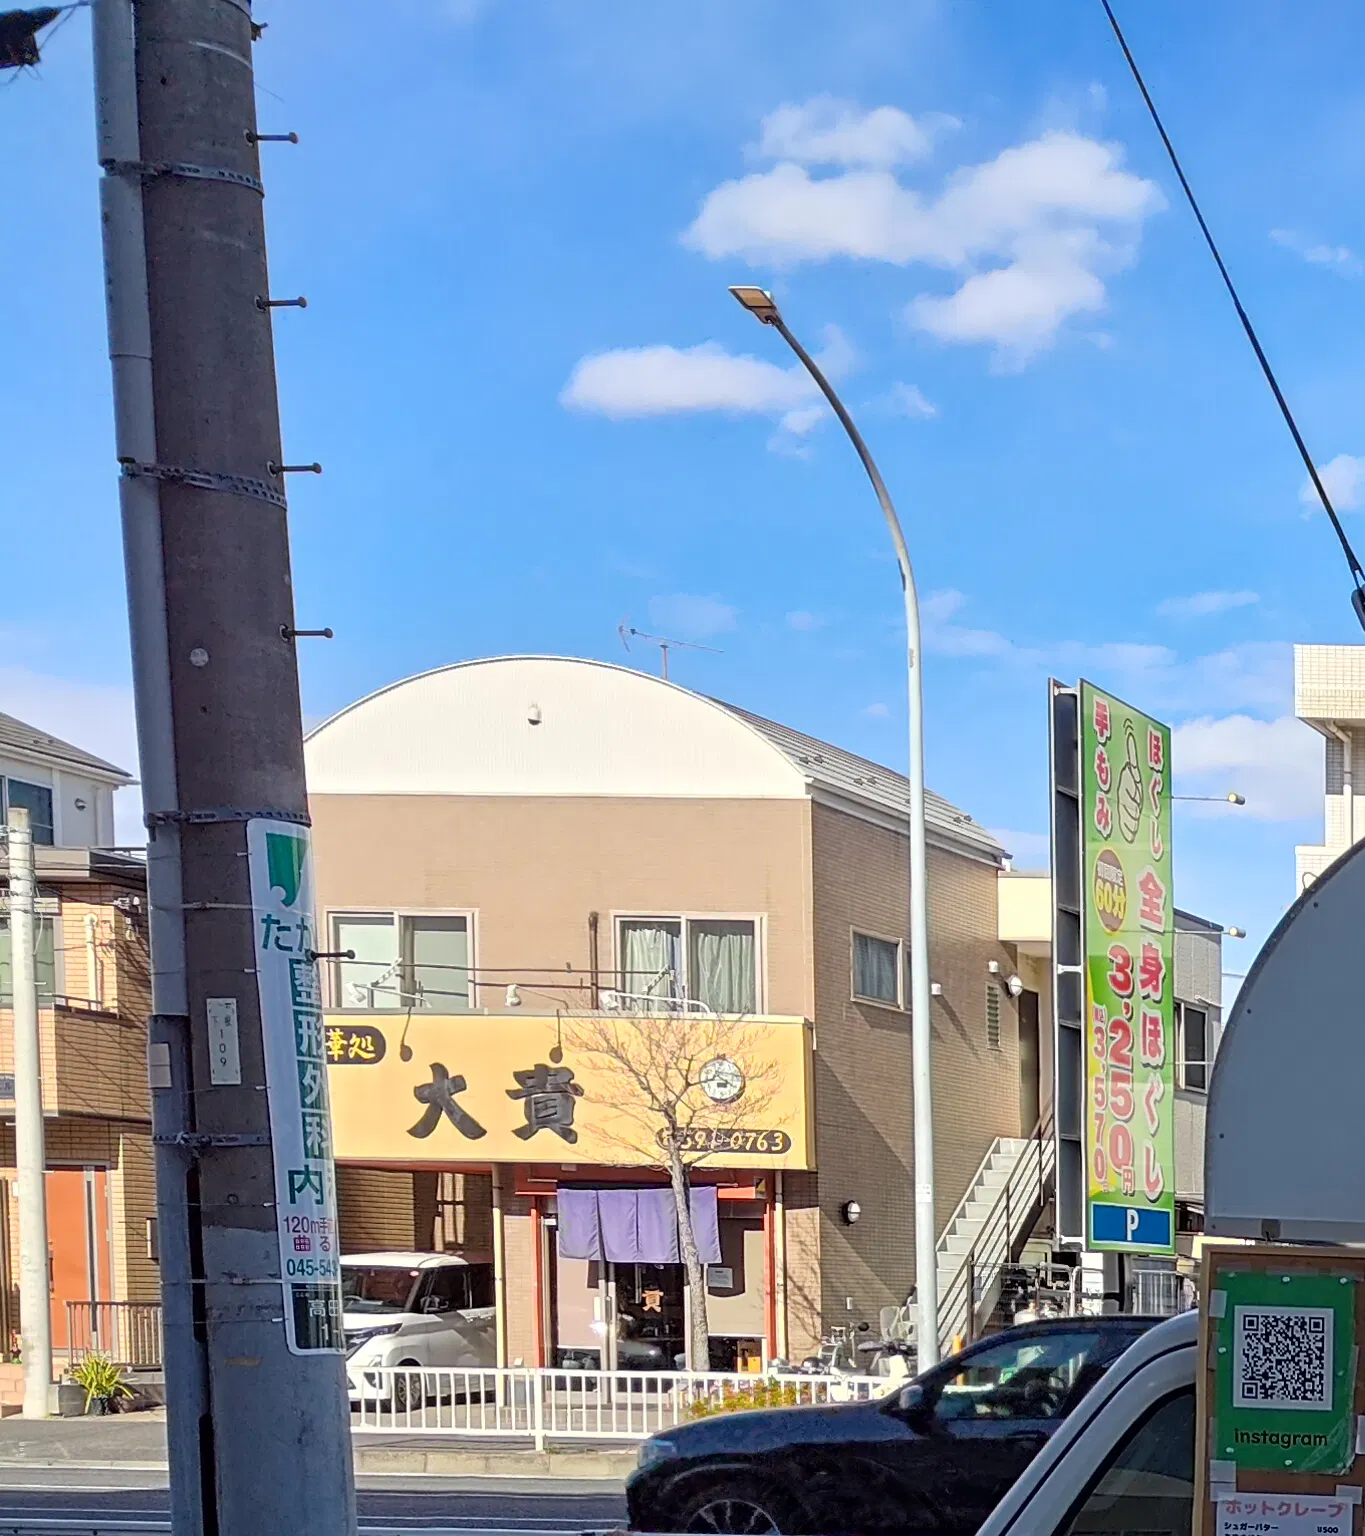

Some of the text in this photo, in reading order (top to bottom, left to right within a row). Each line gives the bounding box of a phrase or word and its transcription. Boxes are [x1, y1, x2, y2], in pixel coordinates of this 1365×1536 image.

[1094, 695, 1112, 840] 手もみ
[1095, 879, 1127, 921] 60分
[1137, 865, 1166, 1203] 全身ほぐし
[406, 1061, 583, 1144] 大貴
[1126, 1209, 1139, 1242] P
[1224, 1522, 1279, 1532] シュガーバター
[1225, 1500, 1348, 1518] ホットクレープ
